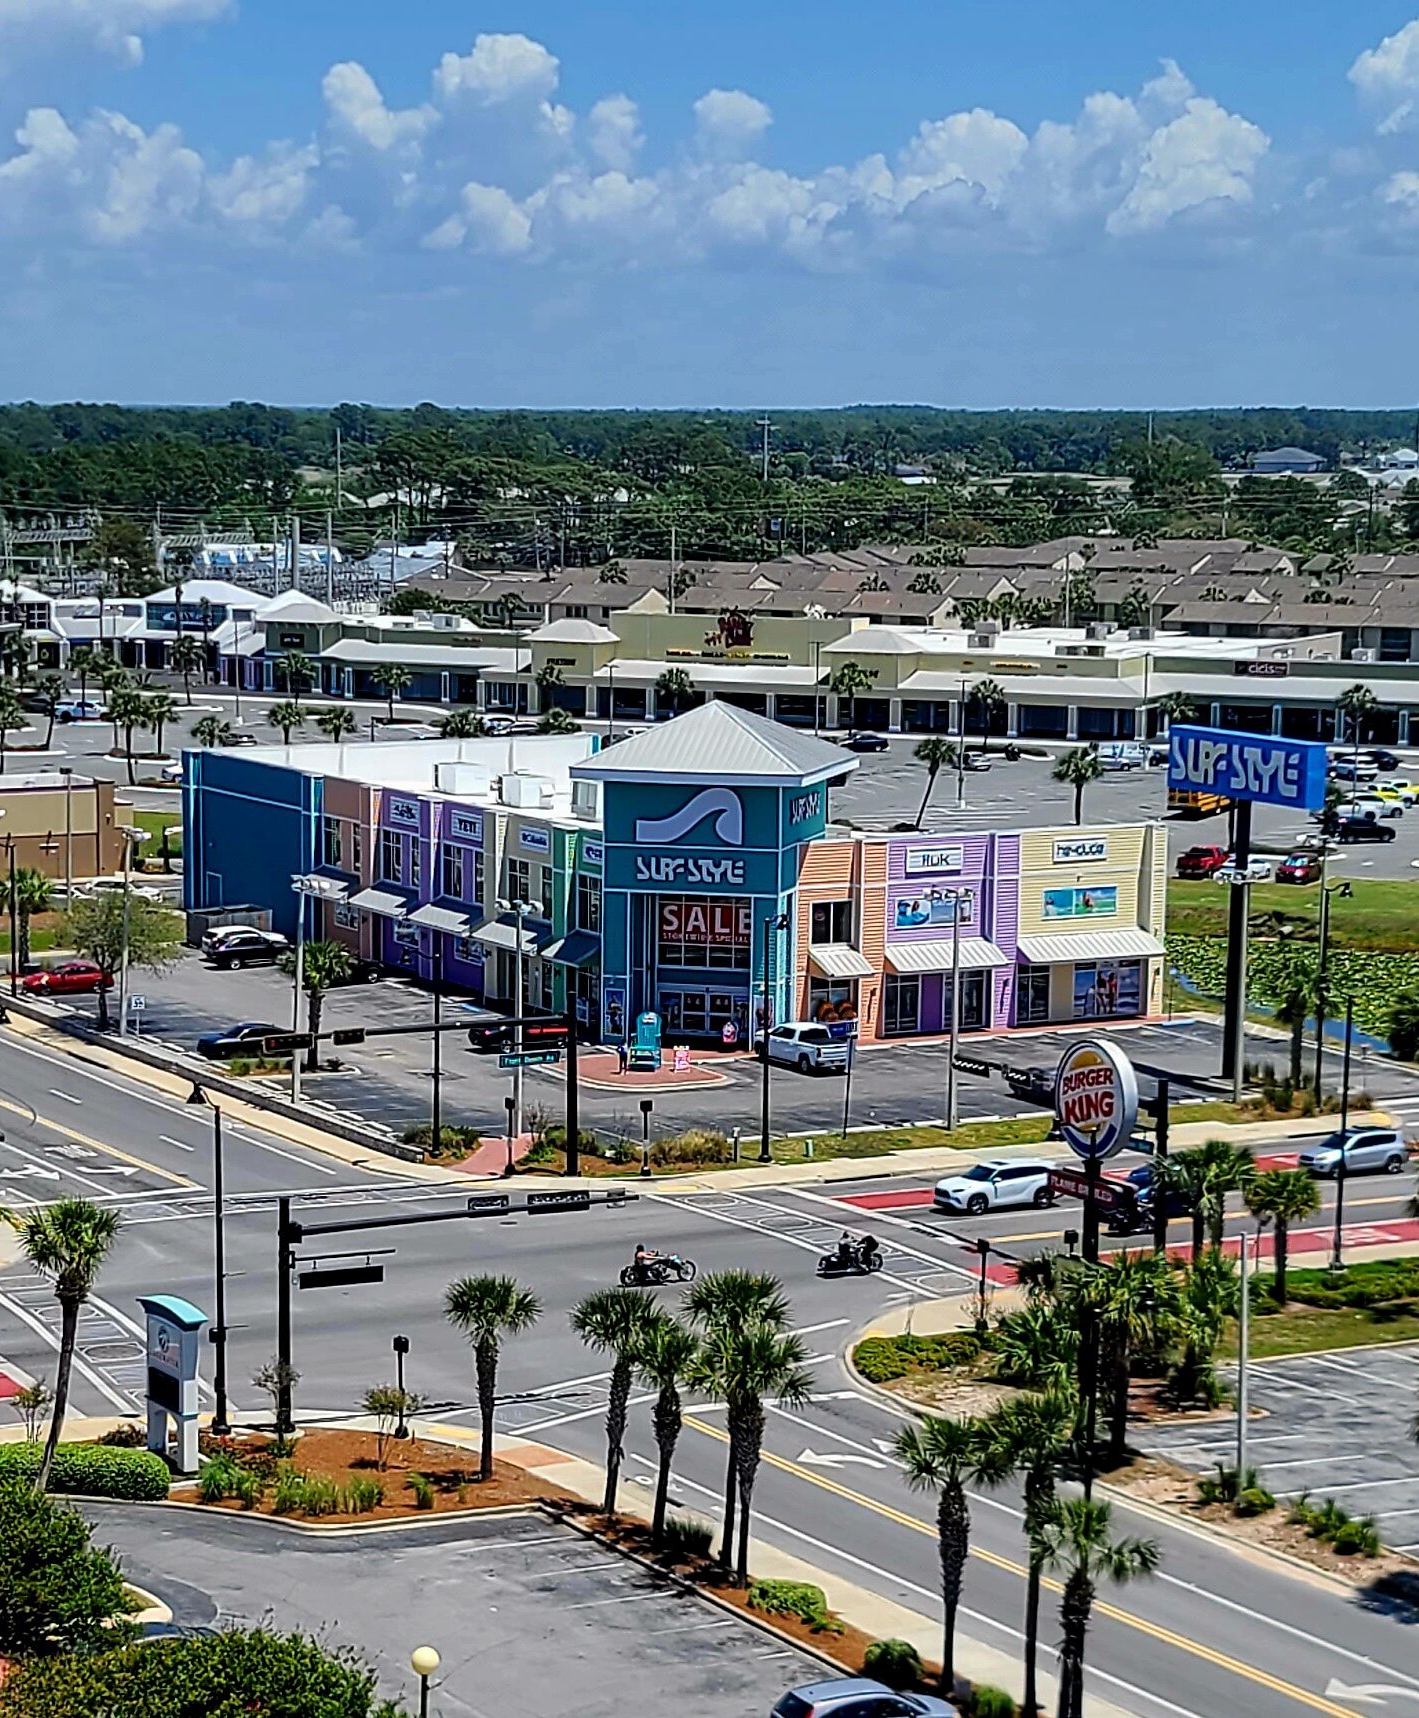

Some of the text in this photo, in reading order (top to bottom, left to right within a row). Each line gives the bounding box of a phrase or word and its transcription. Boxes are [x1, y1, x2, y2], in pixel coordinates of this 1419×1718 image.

[1170, 735, 1301, 799] SURF STYLE
[457, 817, 478, 834] YETI
[637, 856, 744, 884] SURF STYLE
[662, 904, 750, 934] SALE
[1062, 1067, 1114, 1096] BURGER
[1064, 1091, 1114, 1125] KING
